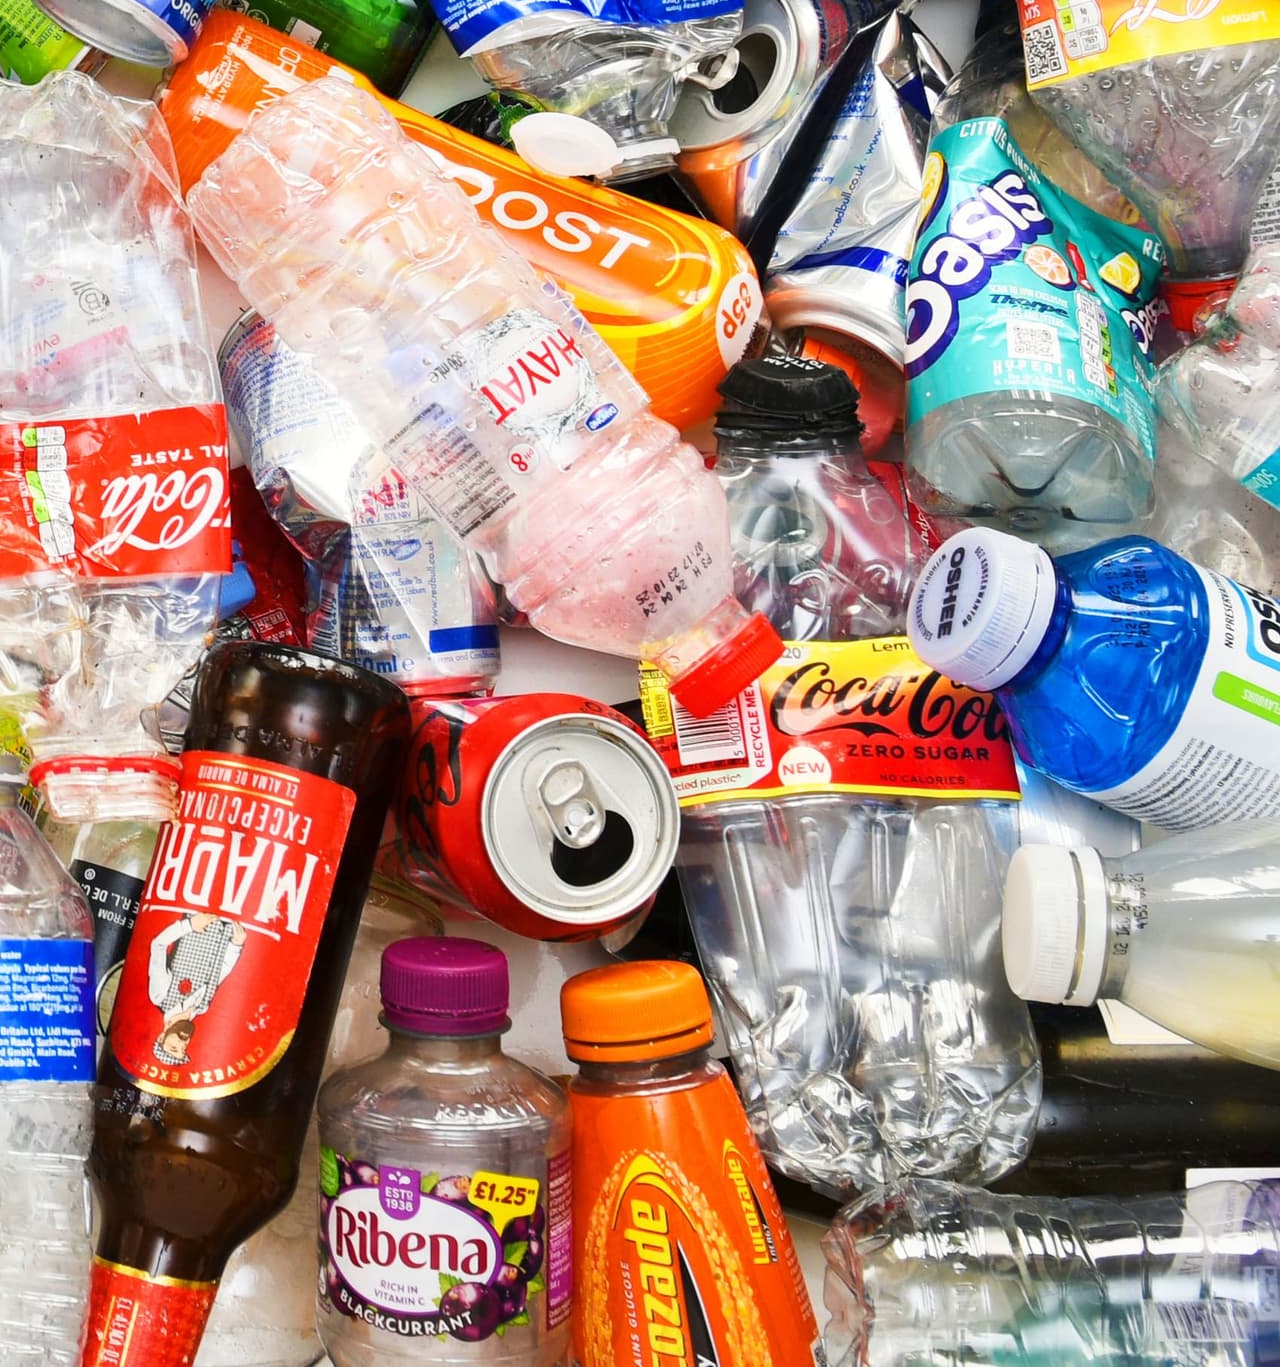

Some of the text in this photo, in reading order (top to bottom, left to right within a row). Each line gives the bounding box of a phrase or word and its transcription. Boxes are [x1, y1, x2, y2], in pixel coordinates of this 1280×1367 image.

[479, 329, 584, 425] HAYAT
[937, 546, 966, 640] OSHEE
[846, 743, 990, 761] ZERO SUGAR
[782, 762, 825, 776] NEW
[385, 1198, 414, 1212] 1938
[335, 1206, 489, 1276] Ribena
[380, 1279, 404, 1293] RICH
[374, 1289, 415, 1305] VITAMIN
[339, 1288, 473, 1335] BLACKCURRANT
